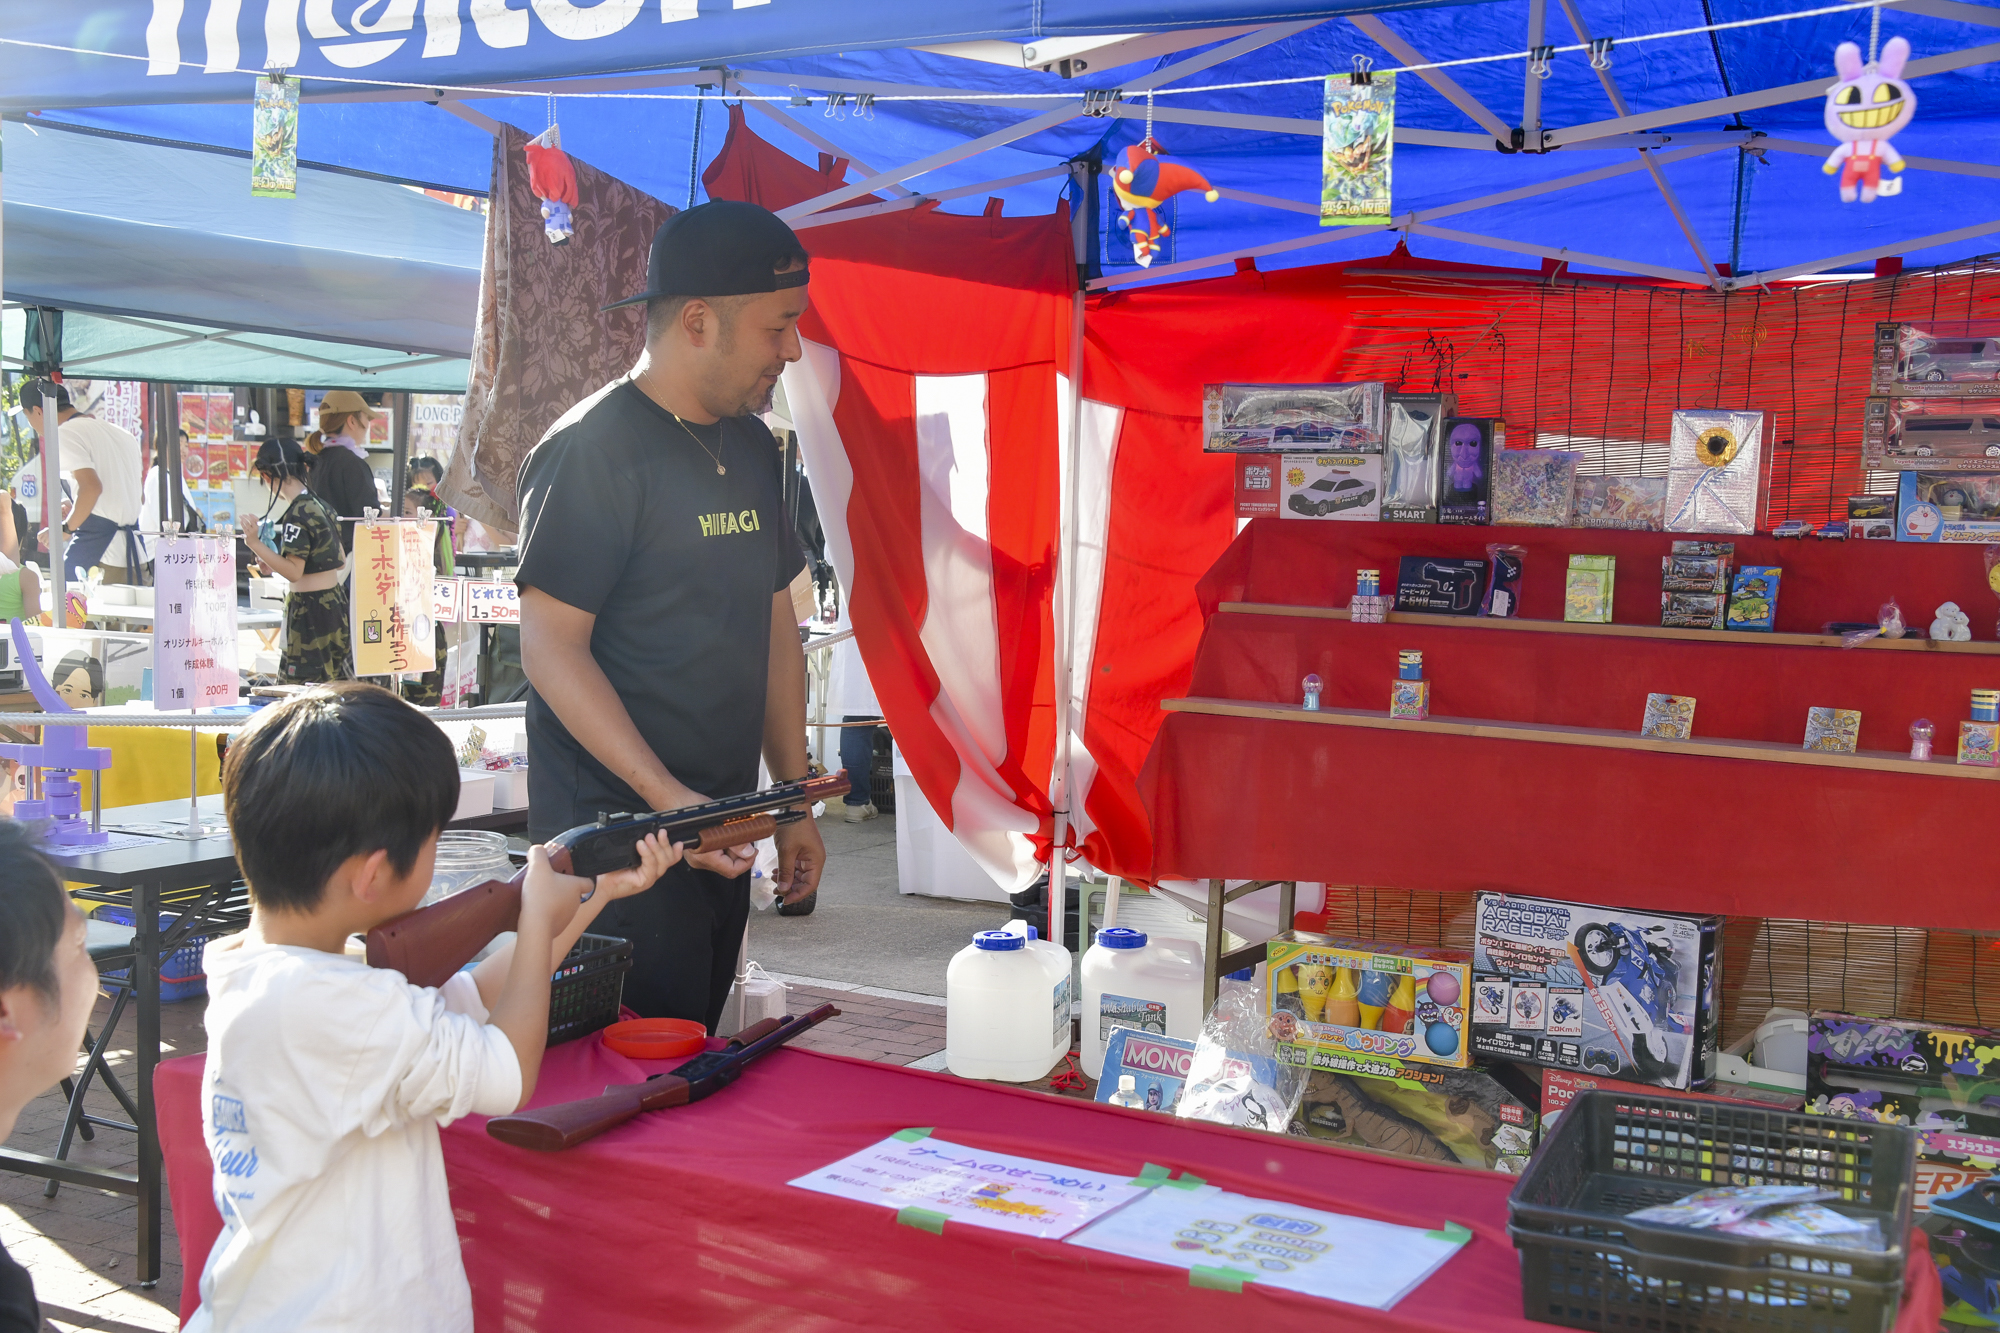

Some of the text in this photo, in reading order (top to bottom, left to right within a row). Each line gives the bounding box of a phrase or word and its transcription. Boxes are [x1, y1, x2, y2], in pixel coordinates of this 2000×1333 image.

[1321, 199, 1390, 217] 変幻の仮面
[415, 406, 449, 422] LONG
[1245, 466, 1272, 476] ポケット
[22, 481, 36, 496] 66
[1245, 477, 1272, 490] トミカ
[1393, 510, 1426, 520] SMART
[371, 526, 400, 605] キーホルダー
[471, 586, 517, 601] どれでも
[168, 603, 182, 614] 1個
[184, 658, 214, 671] 作成体験
[171, 684, 229, 699] 1個 200円
[1500, 900, 1527, 910] RADIO
[1529, 904, 1571, 916] CONTROL
[1482, 905, 1571, 929] ACROBAT
[1482, 917, 1545, 939] RACER
[1100, 1000, 1146, 1015] Washable
[1138, 1009, 1165, 1024] Tank
[1548, 1025, 1581, 1033] 20Km/h
[1346, 1029, 1415, 1057] ボウリング
[1312, 1054, 1444, 1085] 赤外線操作で大迫力のアクション!
[1548, 1072, 1573, 1087] Disney
[1548, 1085, 1577, 1099] Poo
[907, 1146, 1106, 1192] ゲームのせつめい
